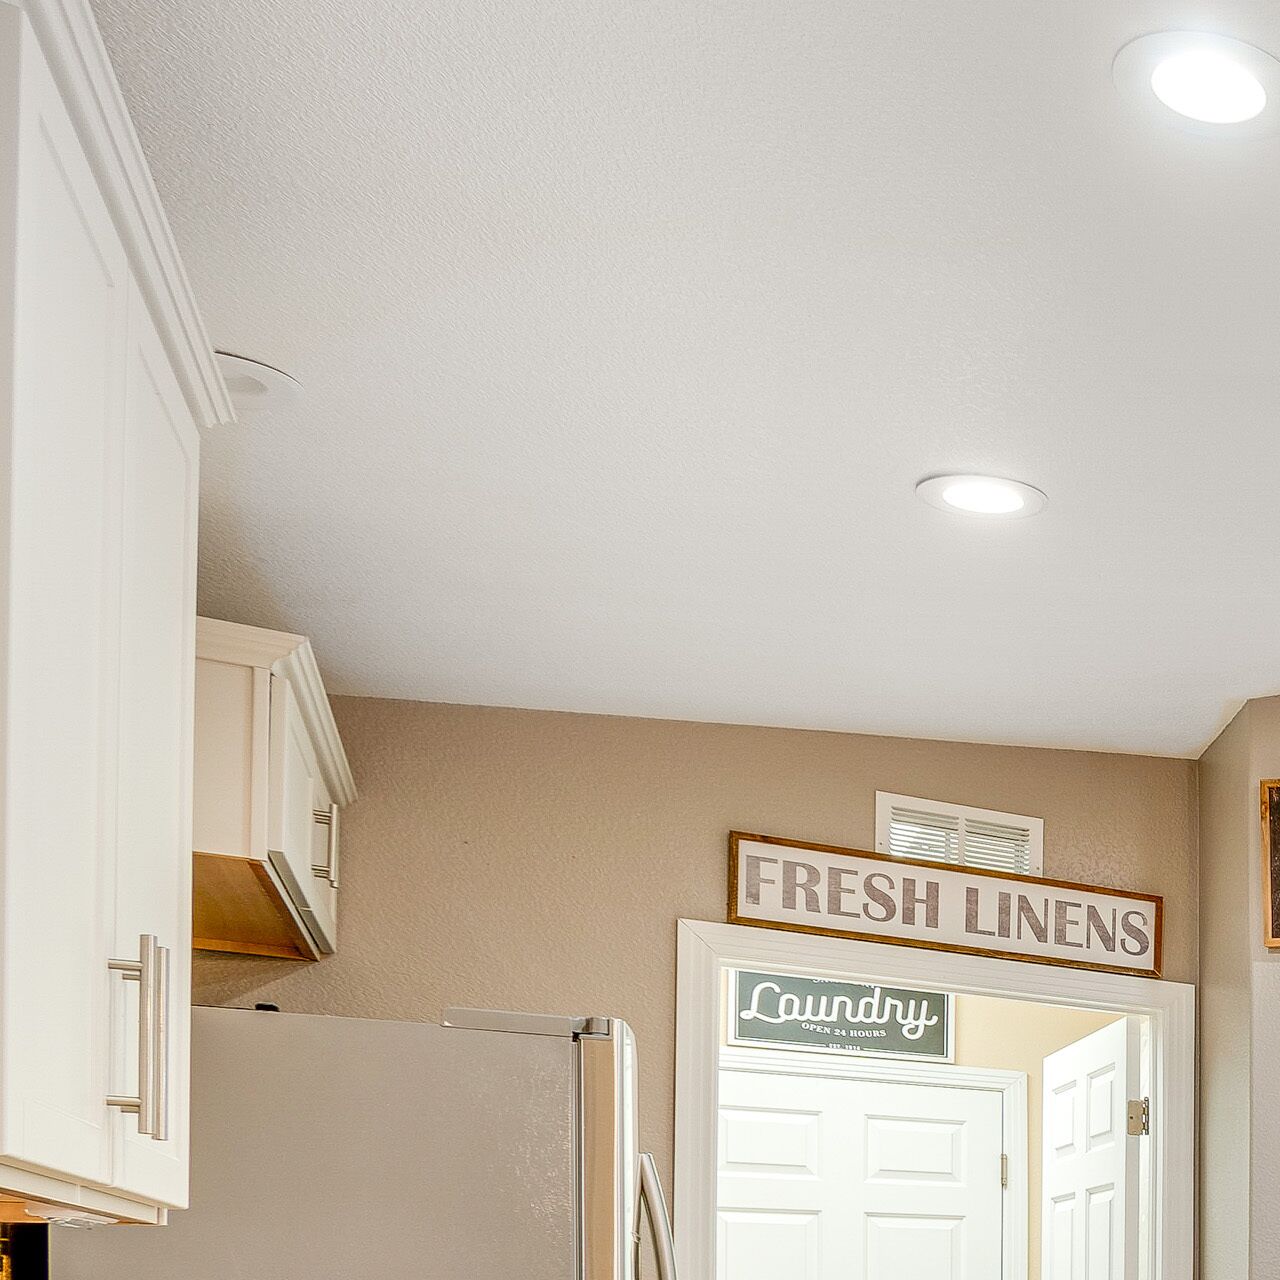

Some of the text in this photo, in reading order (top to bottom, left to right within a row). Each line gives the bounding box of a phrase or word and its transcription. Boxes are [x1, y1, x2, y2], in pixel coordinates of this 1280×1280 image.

[745, 855, 1150, 956] FRESH LINENS
[739, 981, 938, 1040] Laundry
[801, 1022, 887, 1039] OPEN 24 HOURS
